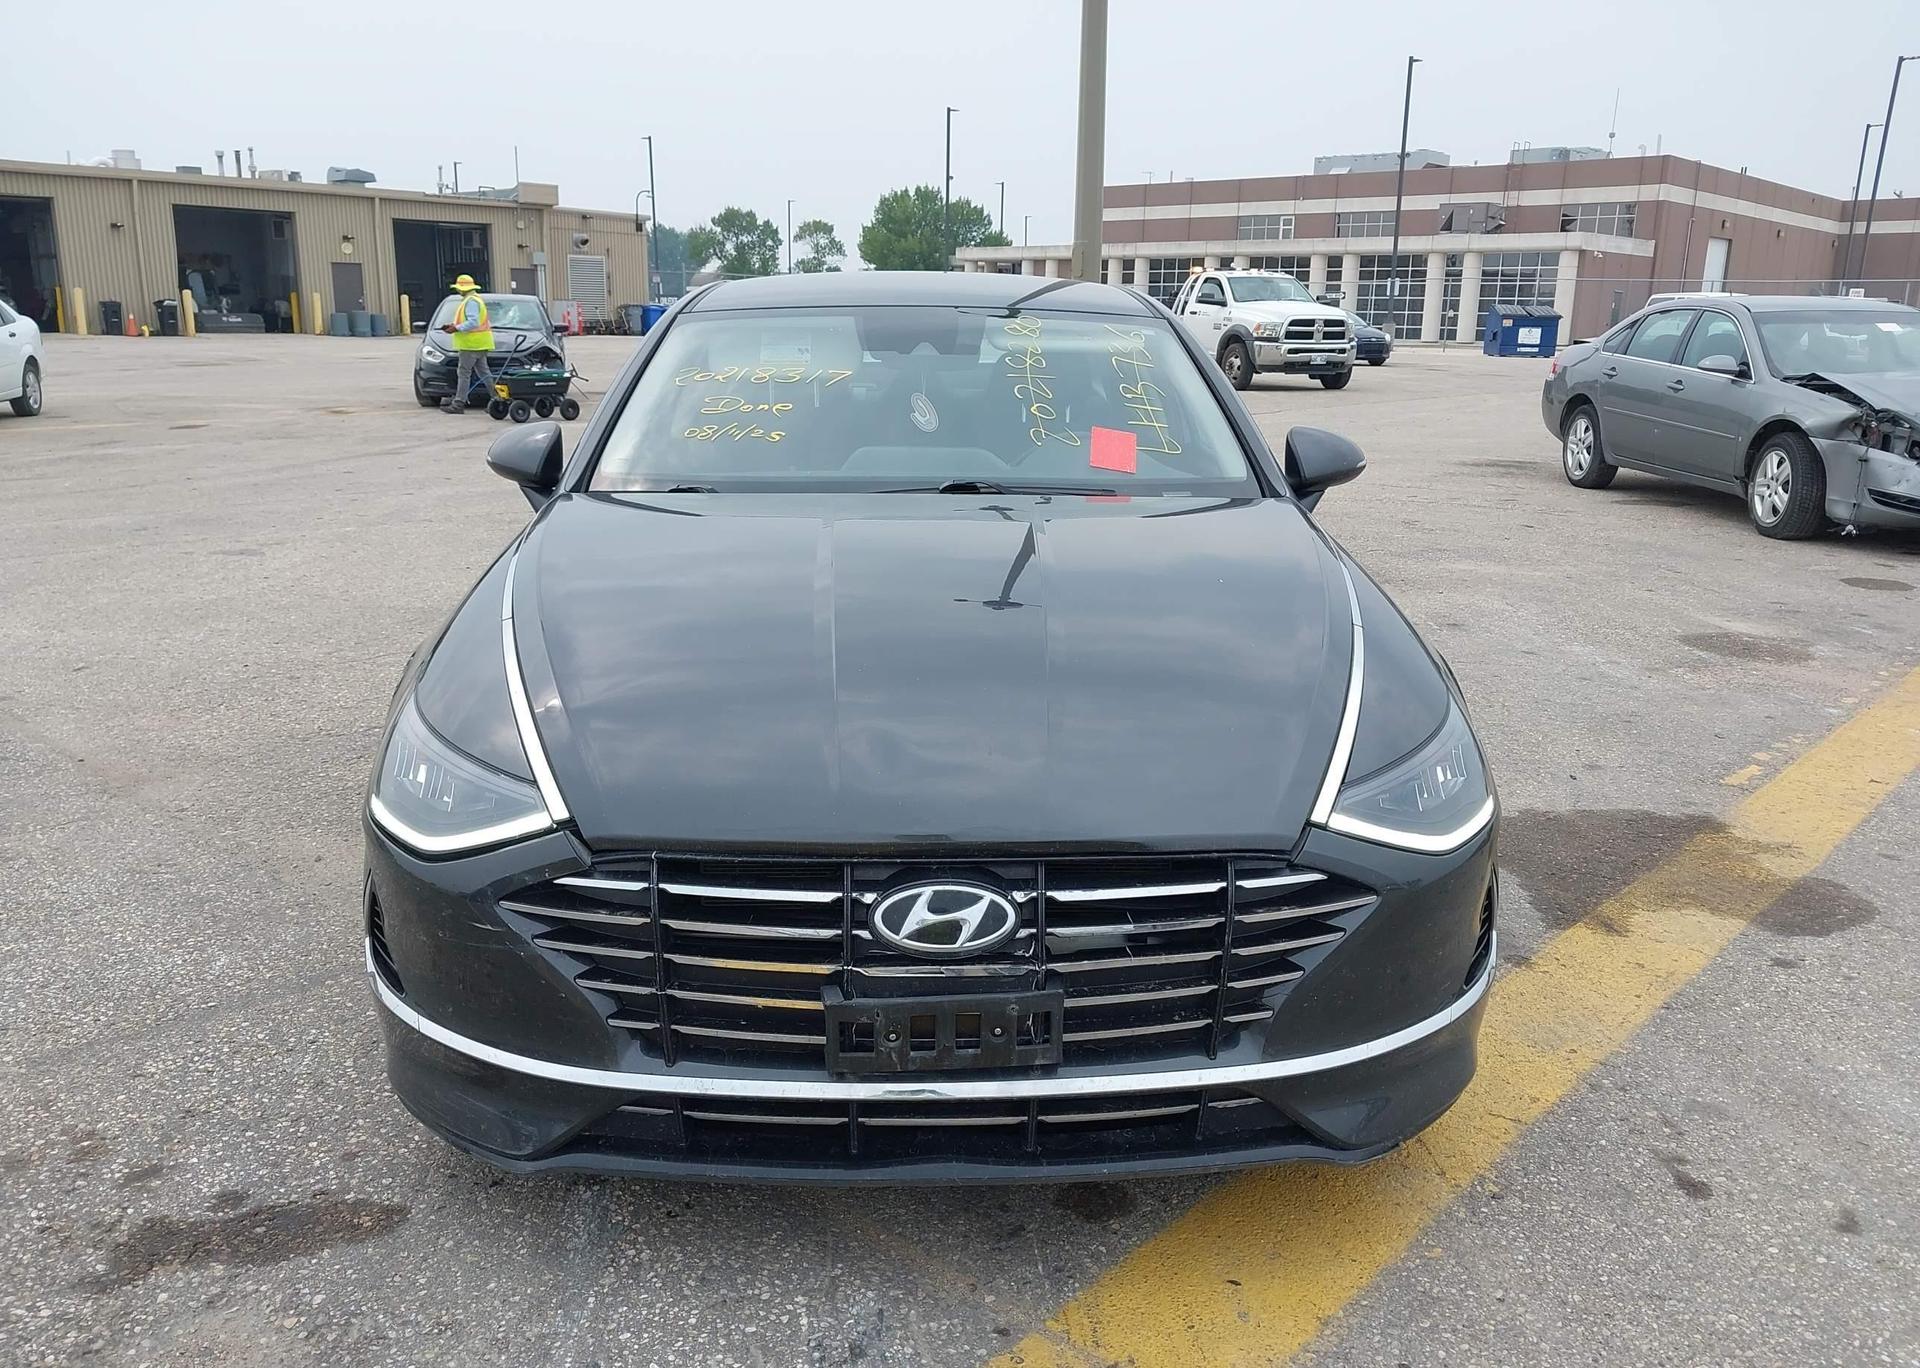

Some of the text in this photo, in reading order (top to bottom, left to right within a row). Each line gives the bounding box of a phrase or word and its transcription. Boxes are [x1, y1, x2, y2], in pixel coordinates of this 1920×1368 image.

[673, 366, 853, 387] 20218317
[700, 395, 793, 418] Done
[683, 422, 786, 442] 08/11/25
